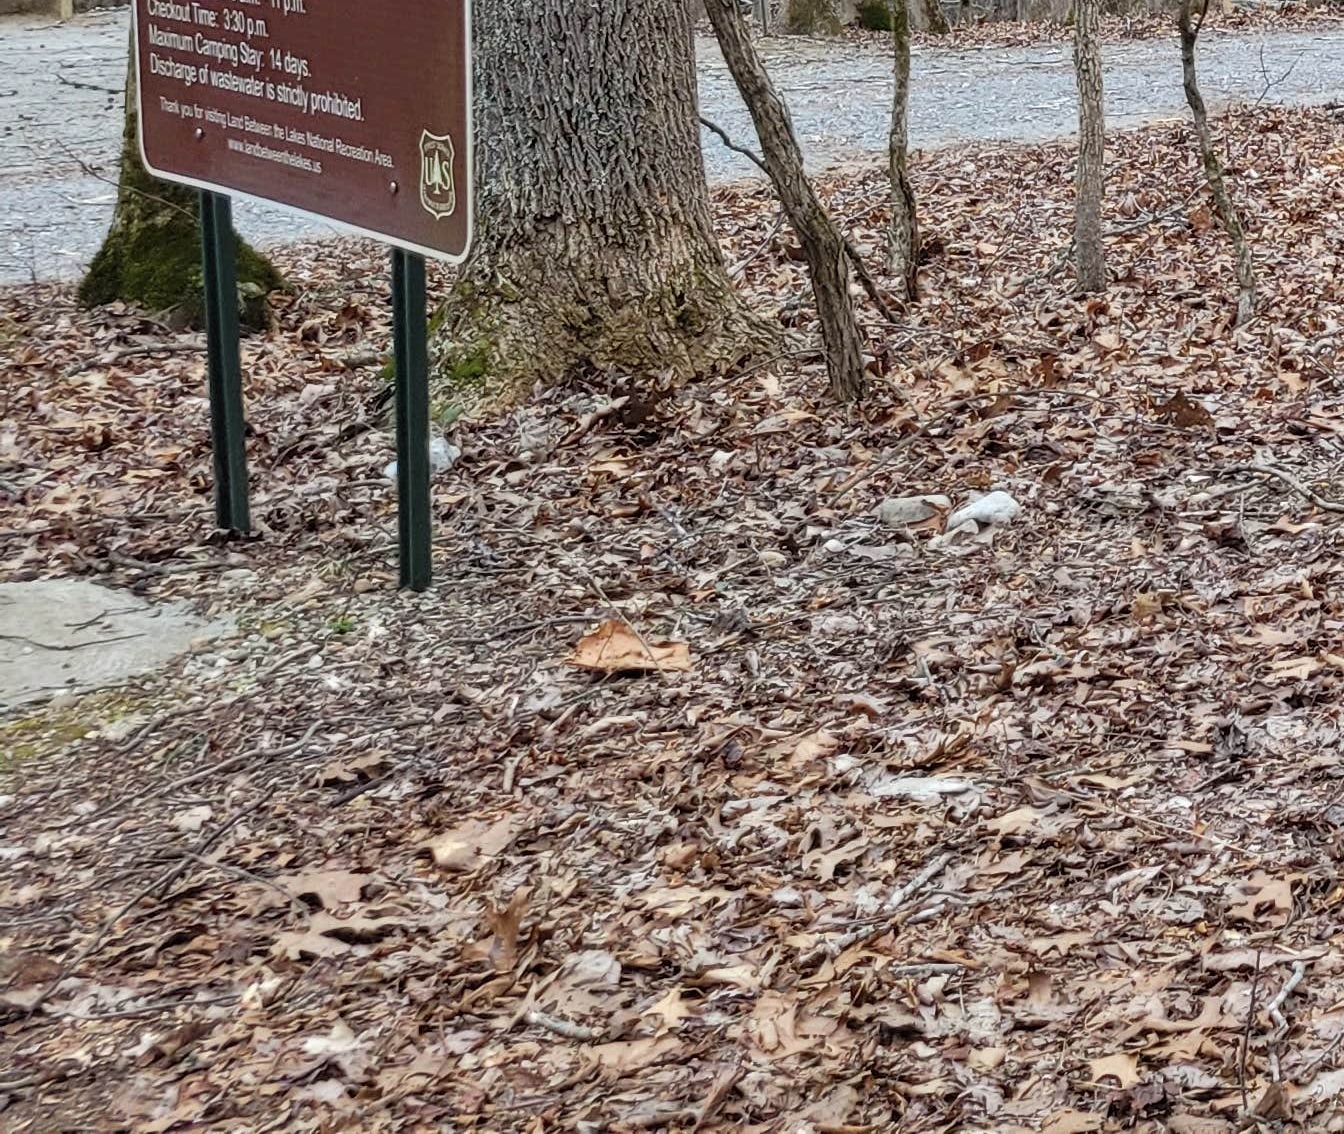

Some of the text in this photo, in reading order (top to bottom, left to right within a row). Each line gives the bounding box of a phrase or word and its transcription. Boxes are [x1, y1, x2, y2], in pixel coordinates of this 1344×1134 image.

[191, 2, 220, 28] Time:
[223, 8, 245, 33] 3:30
[247, 16, 269, 39] p.m.
[149, 24, 311, 80] Maximum Camping Stay: 14 days.
[150, 53, 365, 121] Discharge of wastewater is strictly prohibited.
[160, 96, 394, 167] Thank you for visiting Land Between the Lakes National Recreation Area.
